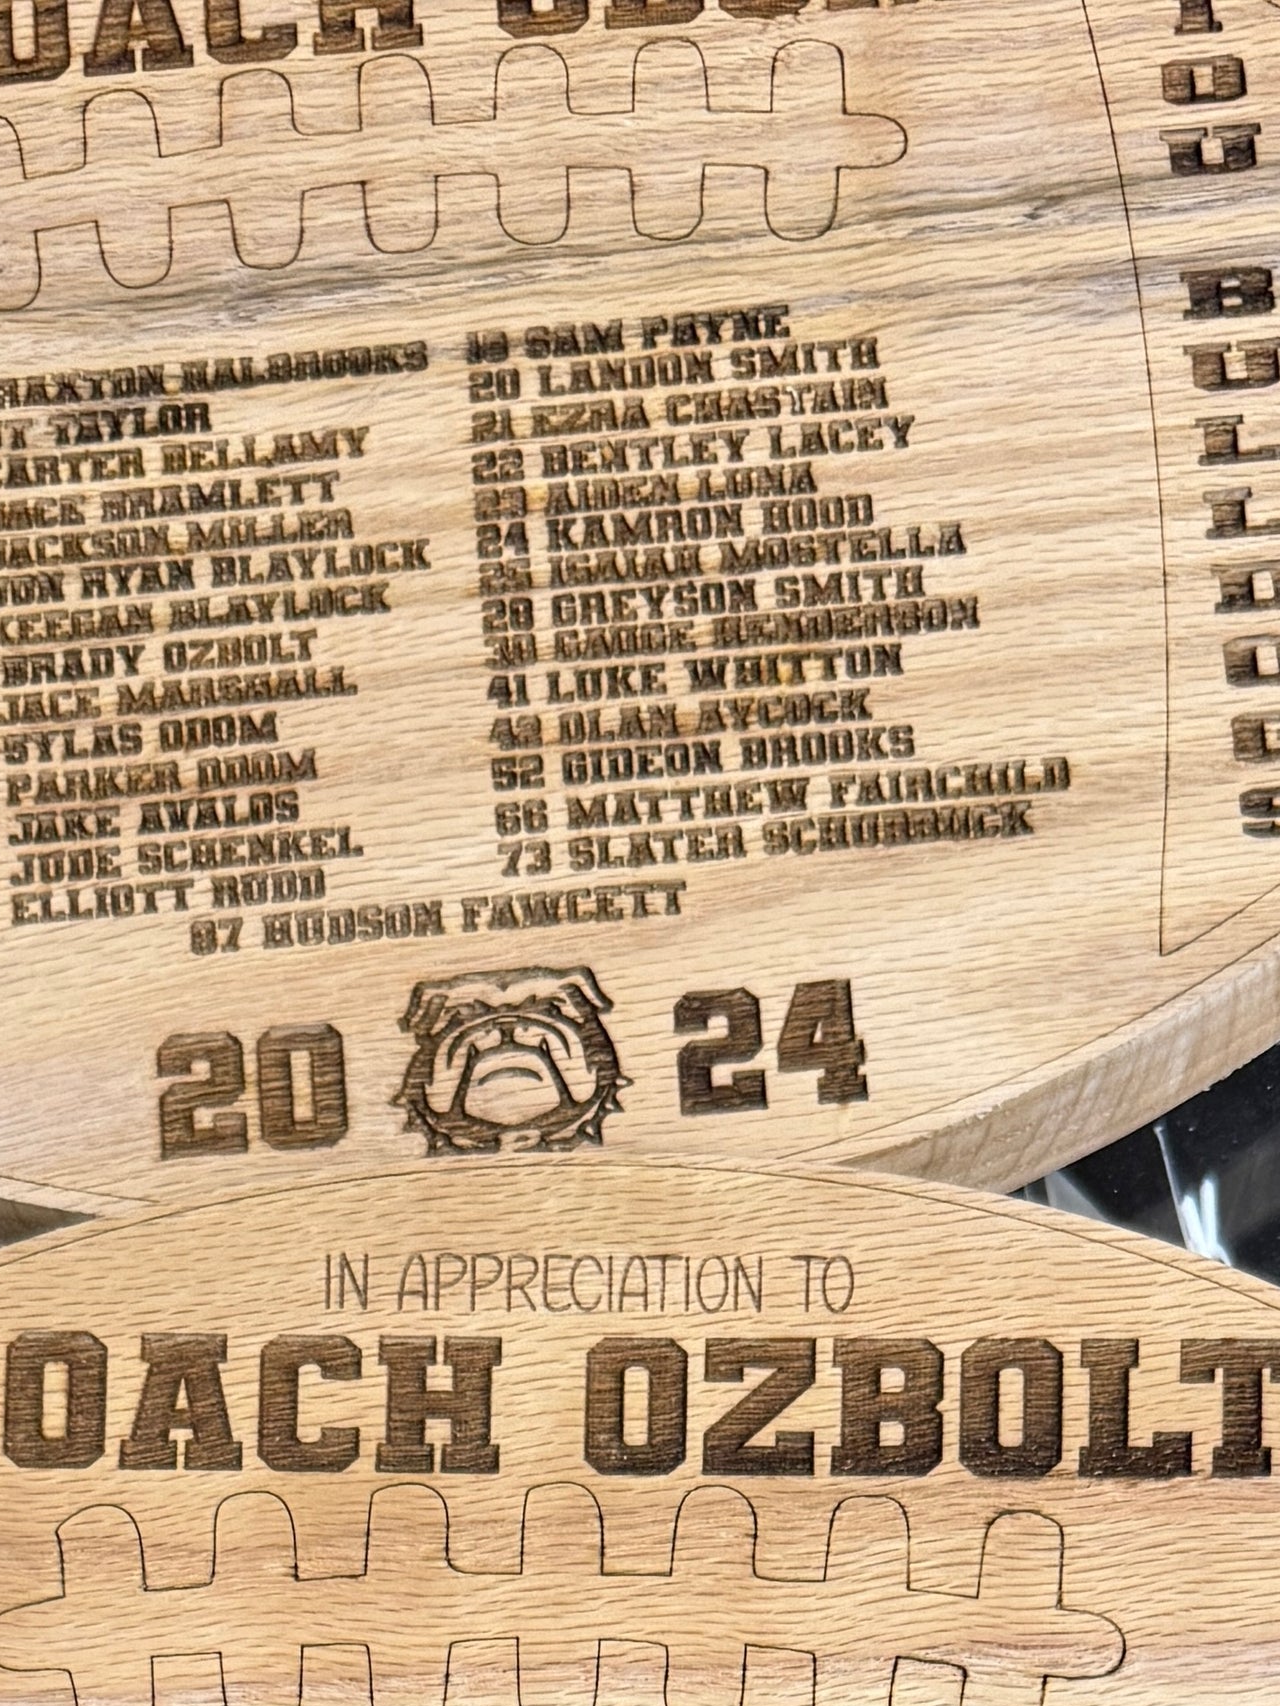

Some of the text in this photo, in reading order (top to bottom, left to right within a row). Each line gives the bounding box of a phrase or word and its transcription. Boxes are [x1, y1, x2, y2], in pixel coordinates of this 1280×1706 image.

[468, 337, 878, 401] 20 LANDON SMITH
[160, 427, 370, 474] BELLAMY
[492, 726, 915, 790] 52 GIDEON BROOKS
[10, 880, 195, 924] ELLIOTT
[211, 869, 325, 907] RUDD
[190, 881, 686, 954] 87 HUDSON FAWCETT
[156, 978, 869, 1161] 20 24
[323, 1253, 855, 1314] IN APPRECIATION TO
